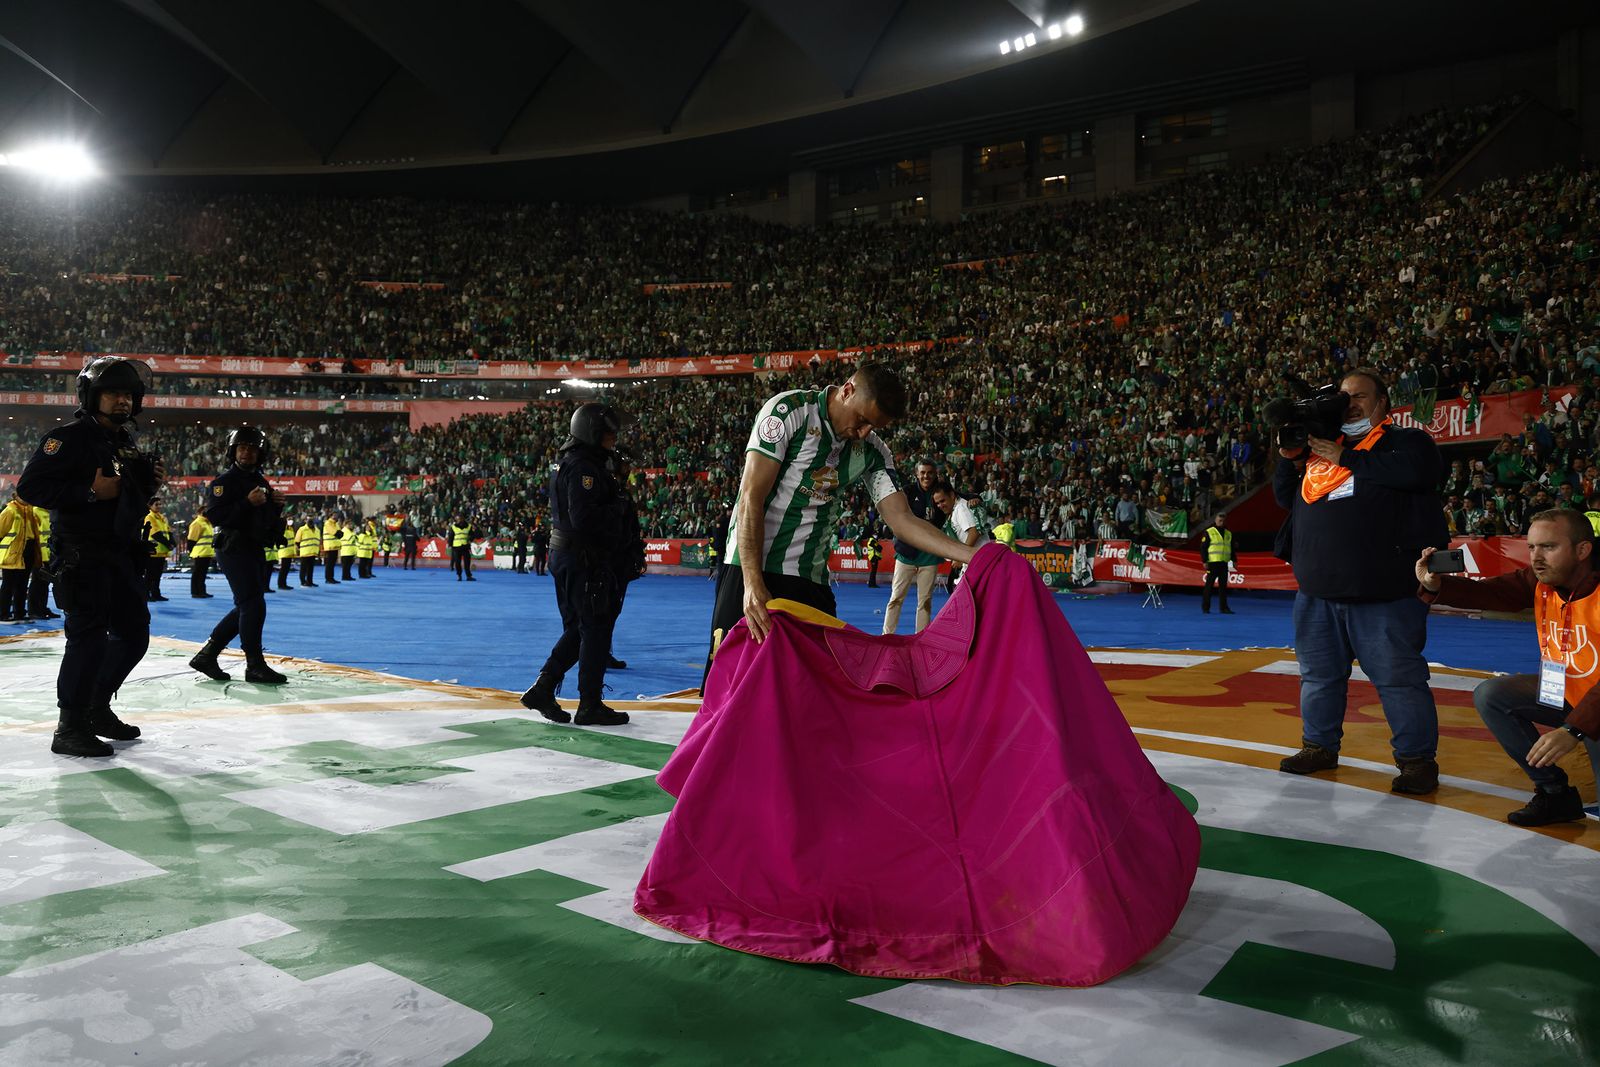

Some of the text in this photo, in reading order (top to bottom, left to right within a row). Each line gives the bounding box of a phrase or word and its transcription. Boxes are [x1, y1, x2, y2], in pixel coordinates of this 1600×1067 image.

[221, 360, 241, 371] COPA
[656, 361, 670, 373] REY
[780, 355, 794, 368] REY
[500, 364, 520, 376] COPA
[305, 480, 321, 491] COPA
